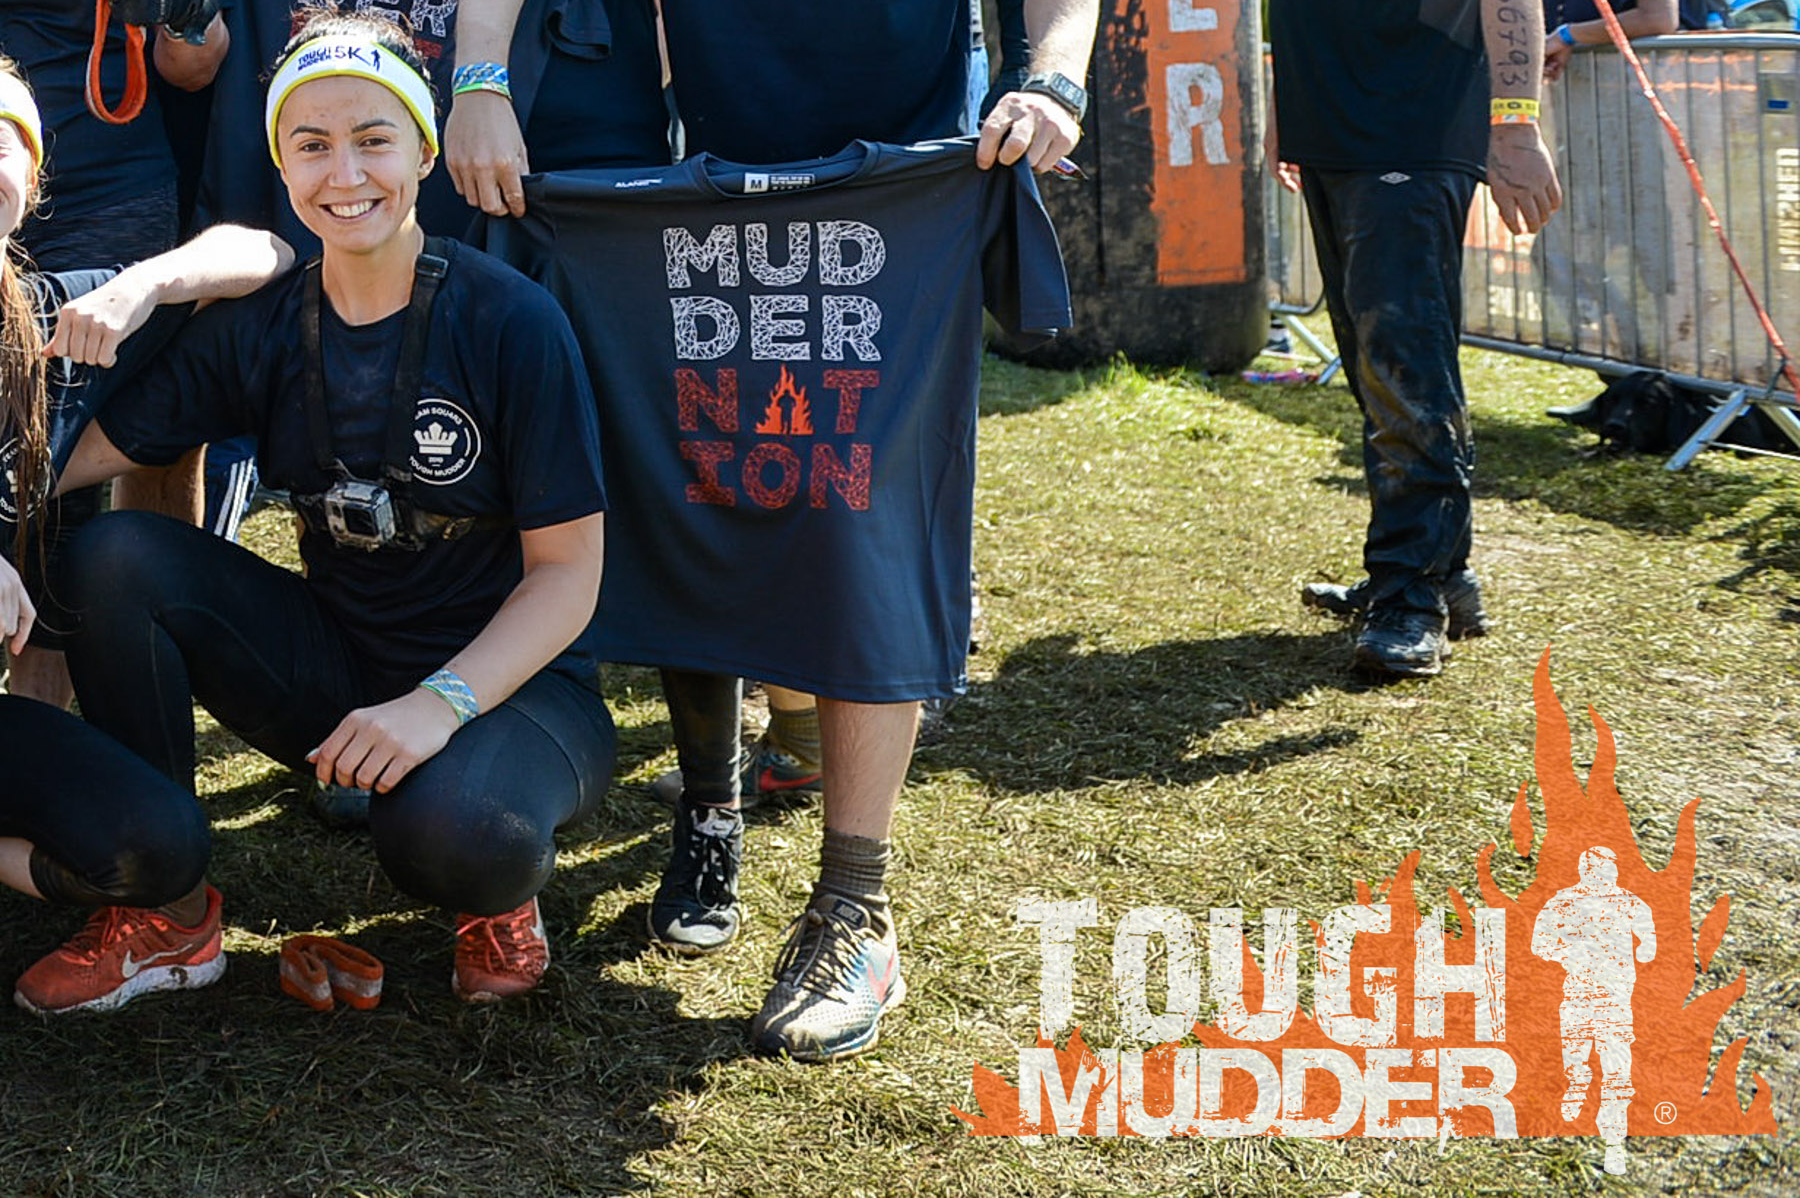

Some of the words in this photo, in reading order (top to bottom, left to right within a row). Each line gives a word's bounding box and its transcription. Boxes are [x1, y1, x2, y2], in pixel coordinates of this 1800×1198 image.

[298, 46, 331, 65] TOUGH
[335, 46, 370, 66] 5K
[663, 219, 886, 288] MUD
[670, 295, 882, 361] DER
[678, 441, 873, 510] ION
